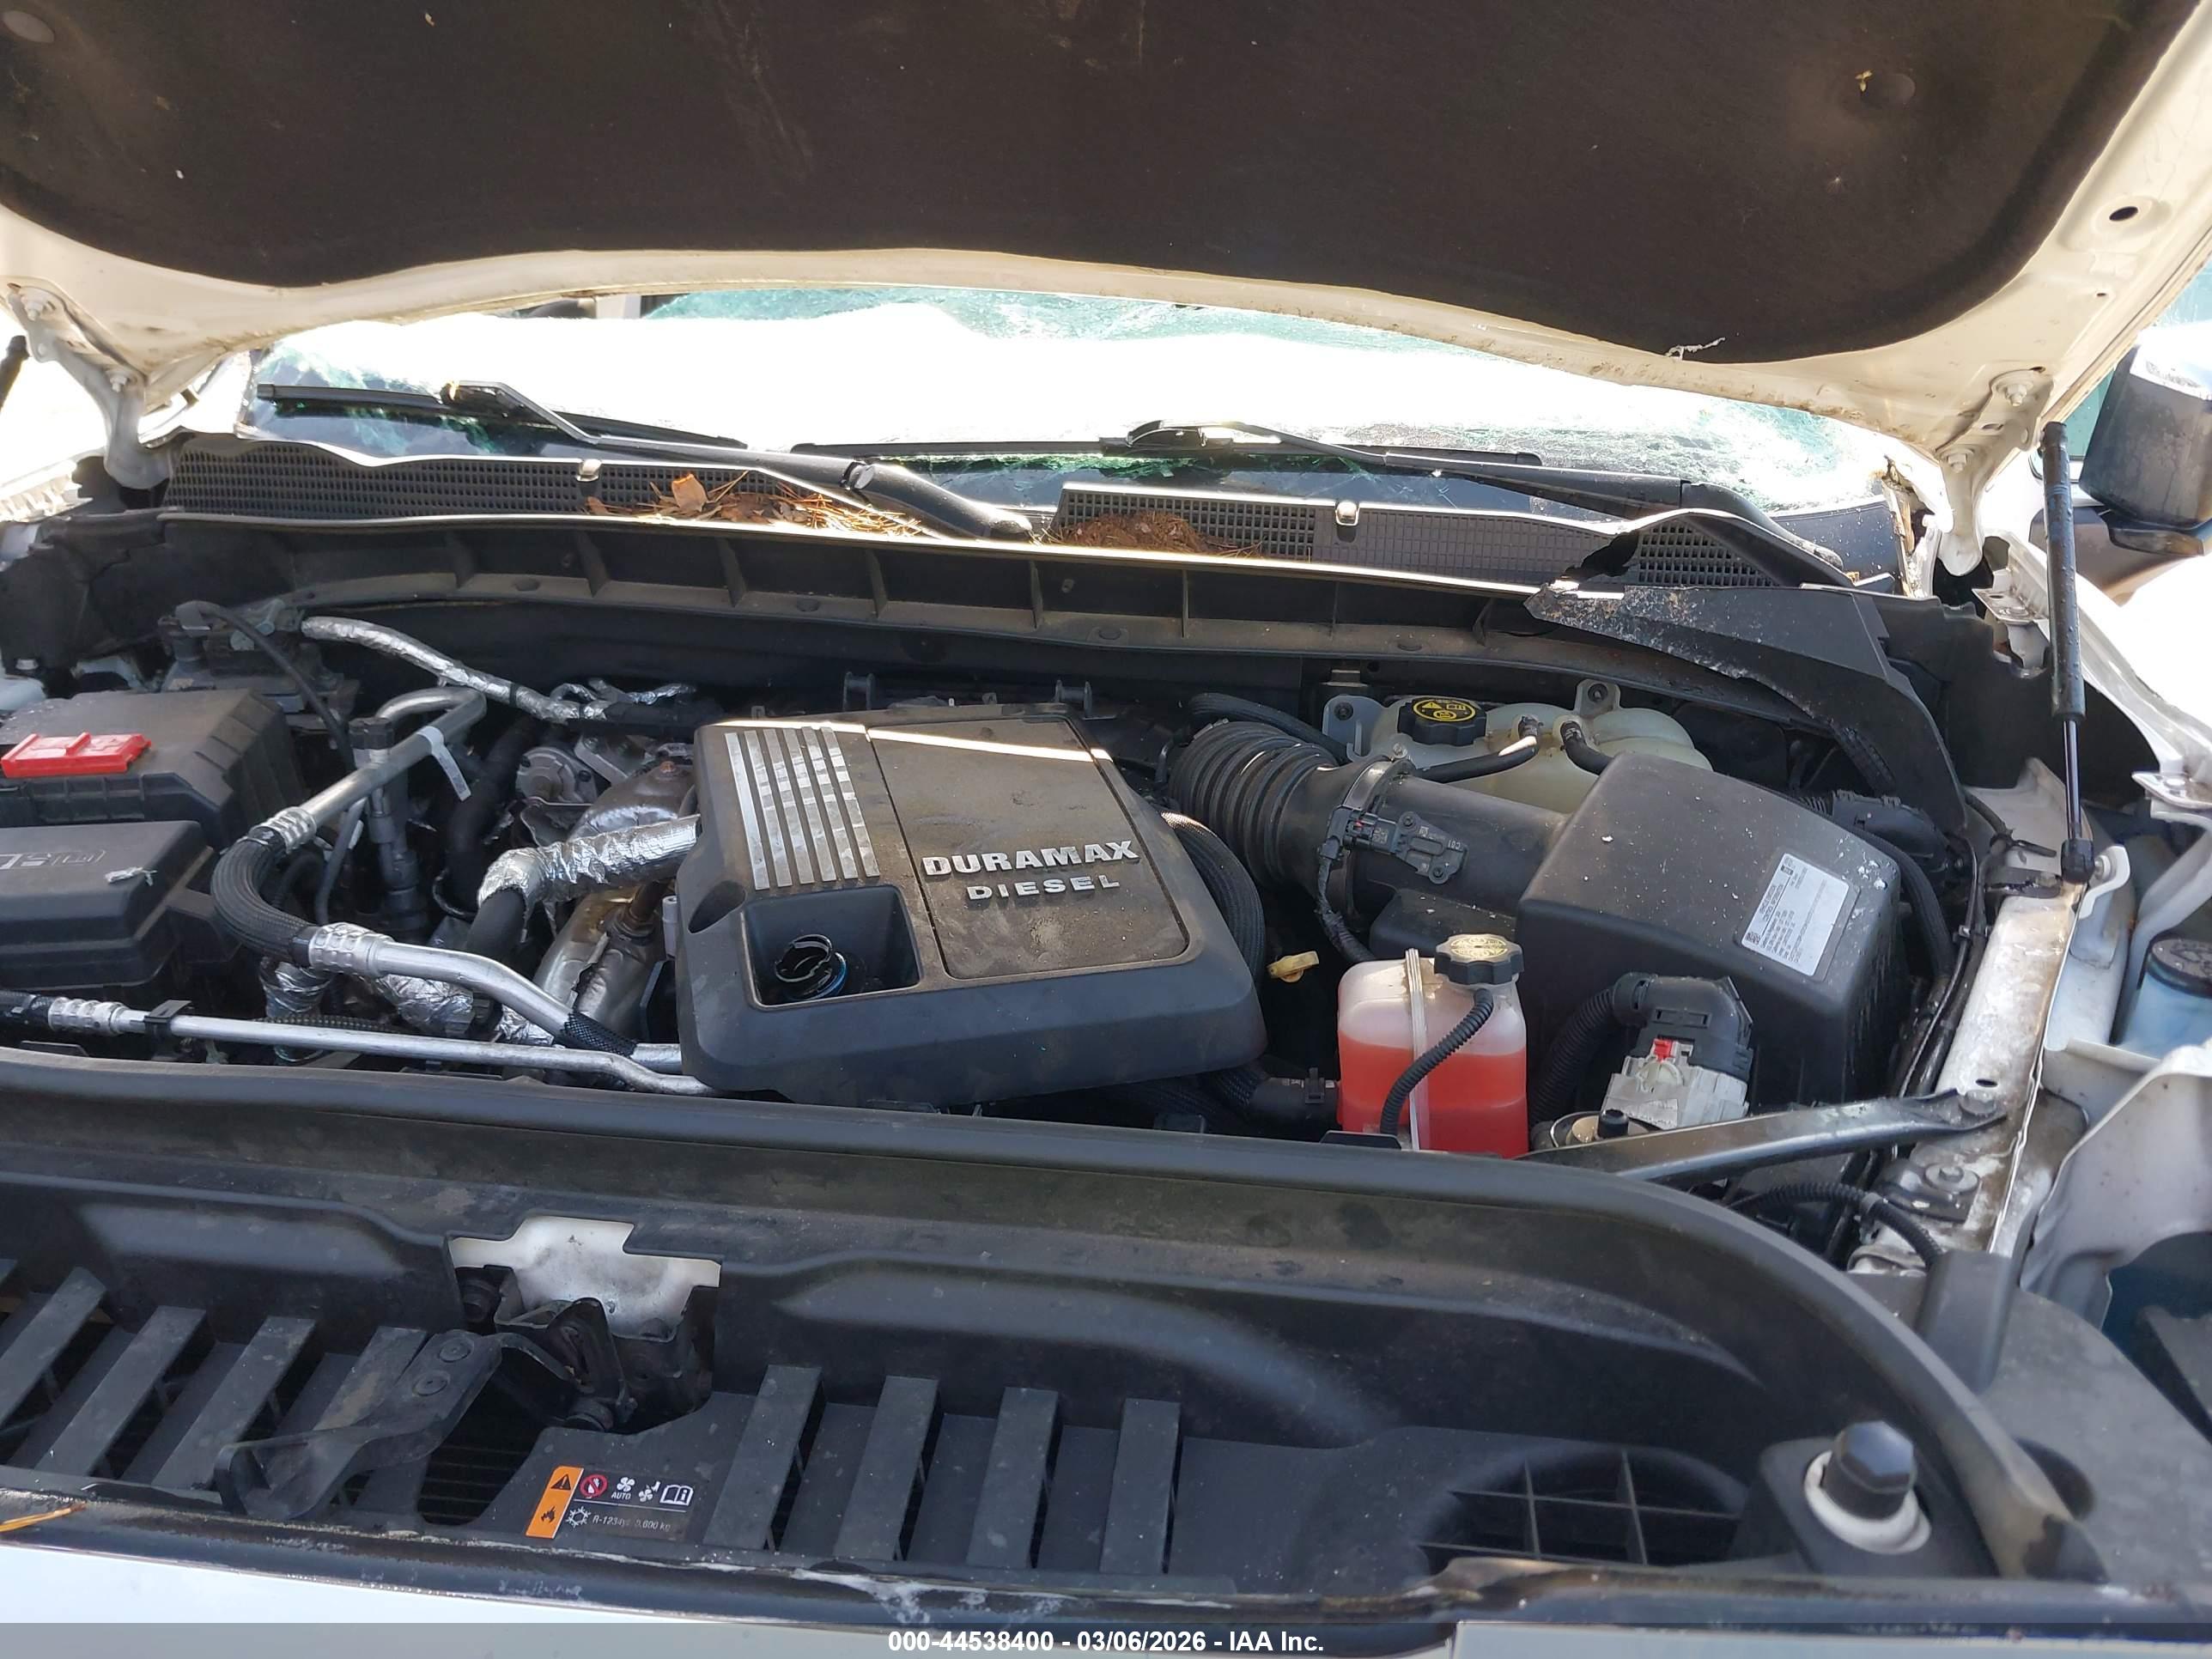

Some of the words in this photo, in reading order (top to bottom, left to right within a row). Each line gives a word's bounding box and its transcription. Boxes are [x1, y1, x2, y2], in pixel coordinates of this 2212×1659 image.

[921, 840, 1139, 876] DURAMAX
[966, 874, 1120, 900] DIESEL
[611, 1491, 631, 1500] AUTO
